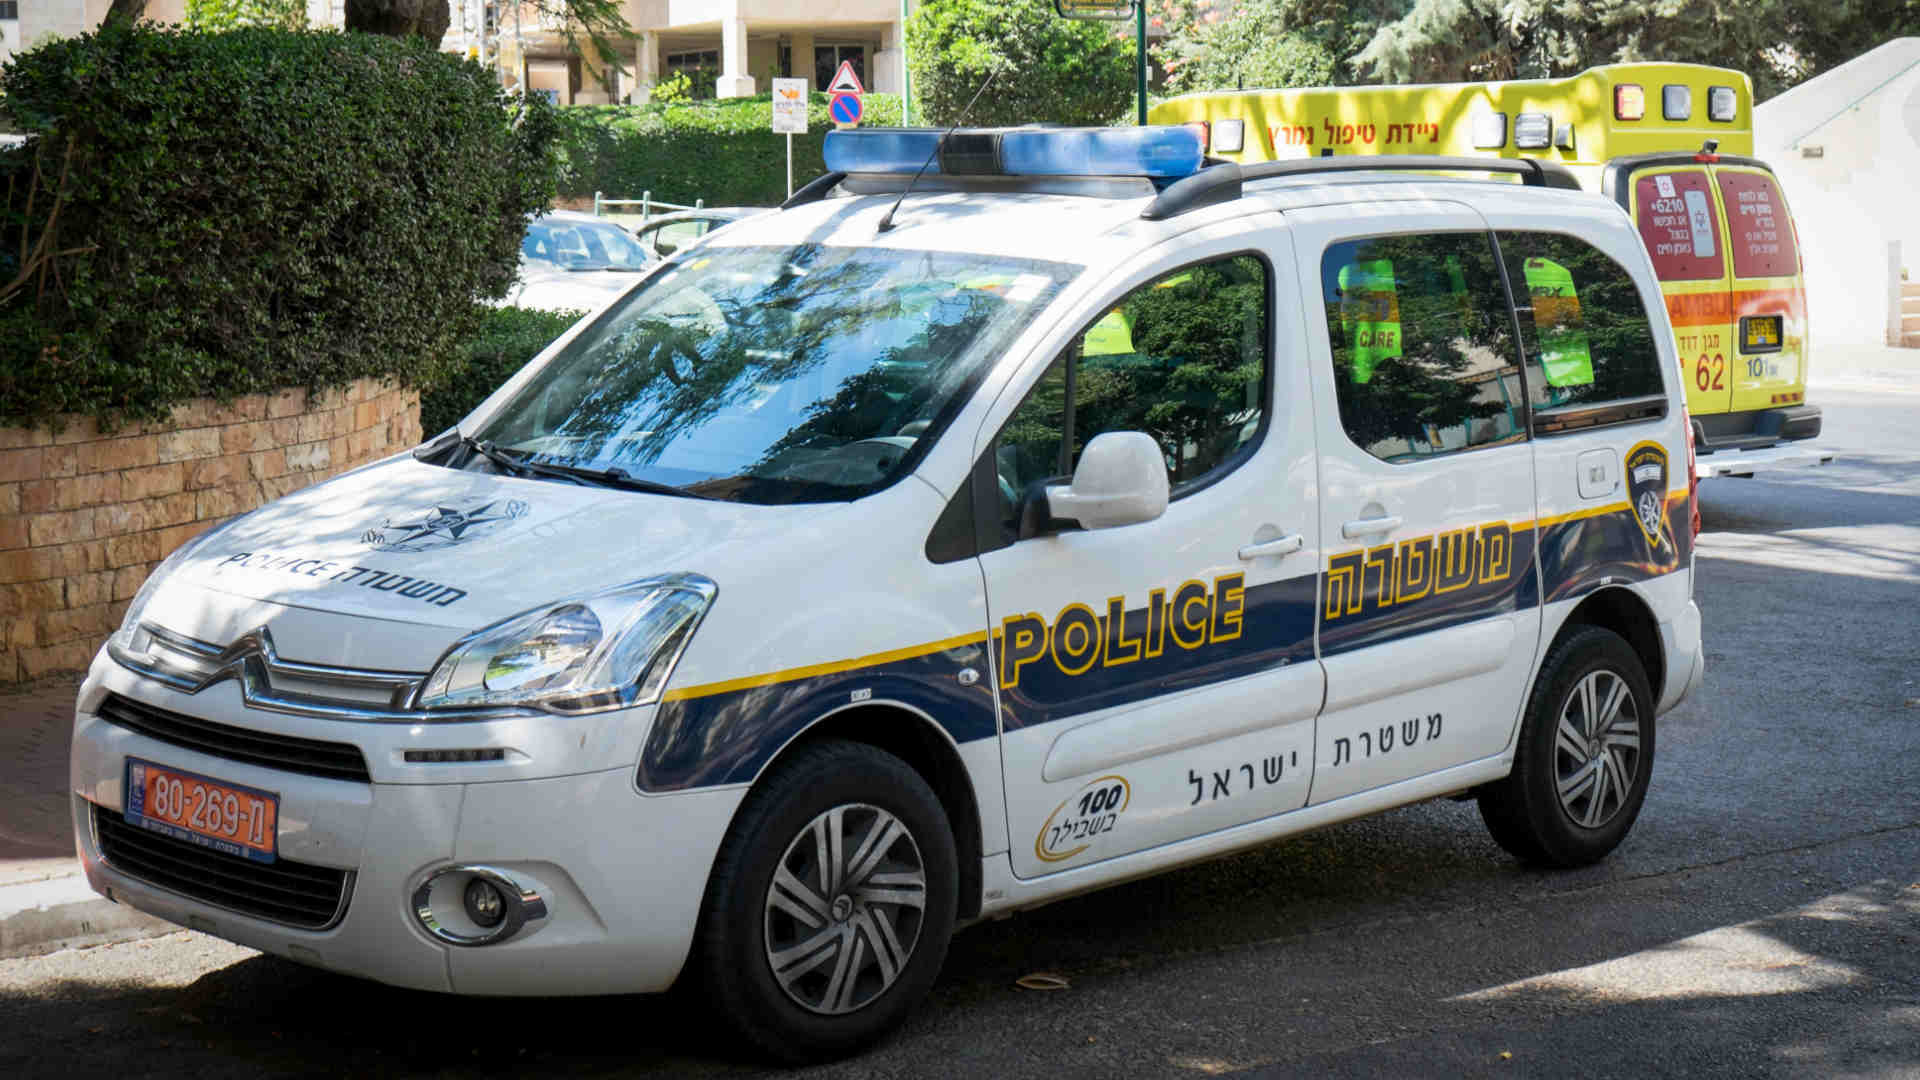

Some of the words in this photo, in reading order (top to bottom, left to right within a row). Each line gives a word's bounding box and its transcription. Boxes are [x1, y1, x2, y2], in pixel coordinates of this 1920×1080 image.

[1267, 124, 1315, 151] נמרץ
[1324, 117, 1377, 145] טיפול
[1385, 123, 1440, 144] ניידת
[1695, 353, 1724, 392] 62
[218, 552, 337, 577] POLICE
[330, 566, 467, 607] משטרה
[1325, 521, 1514, 620] משטרה
[1000, 572, 1246, 689] POLICE
[1332, 712, 1443, 767] משטרת
[1188, 751, 1299, 806] ישראל
[1077, 784, 1123, 817] 100
[1049, 812, 1118, 852] בשבילך
